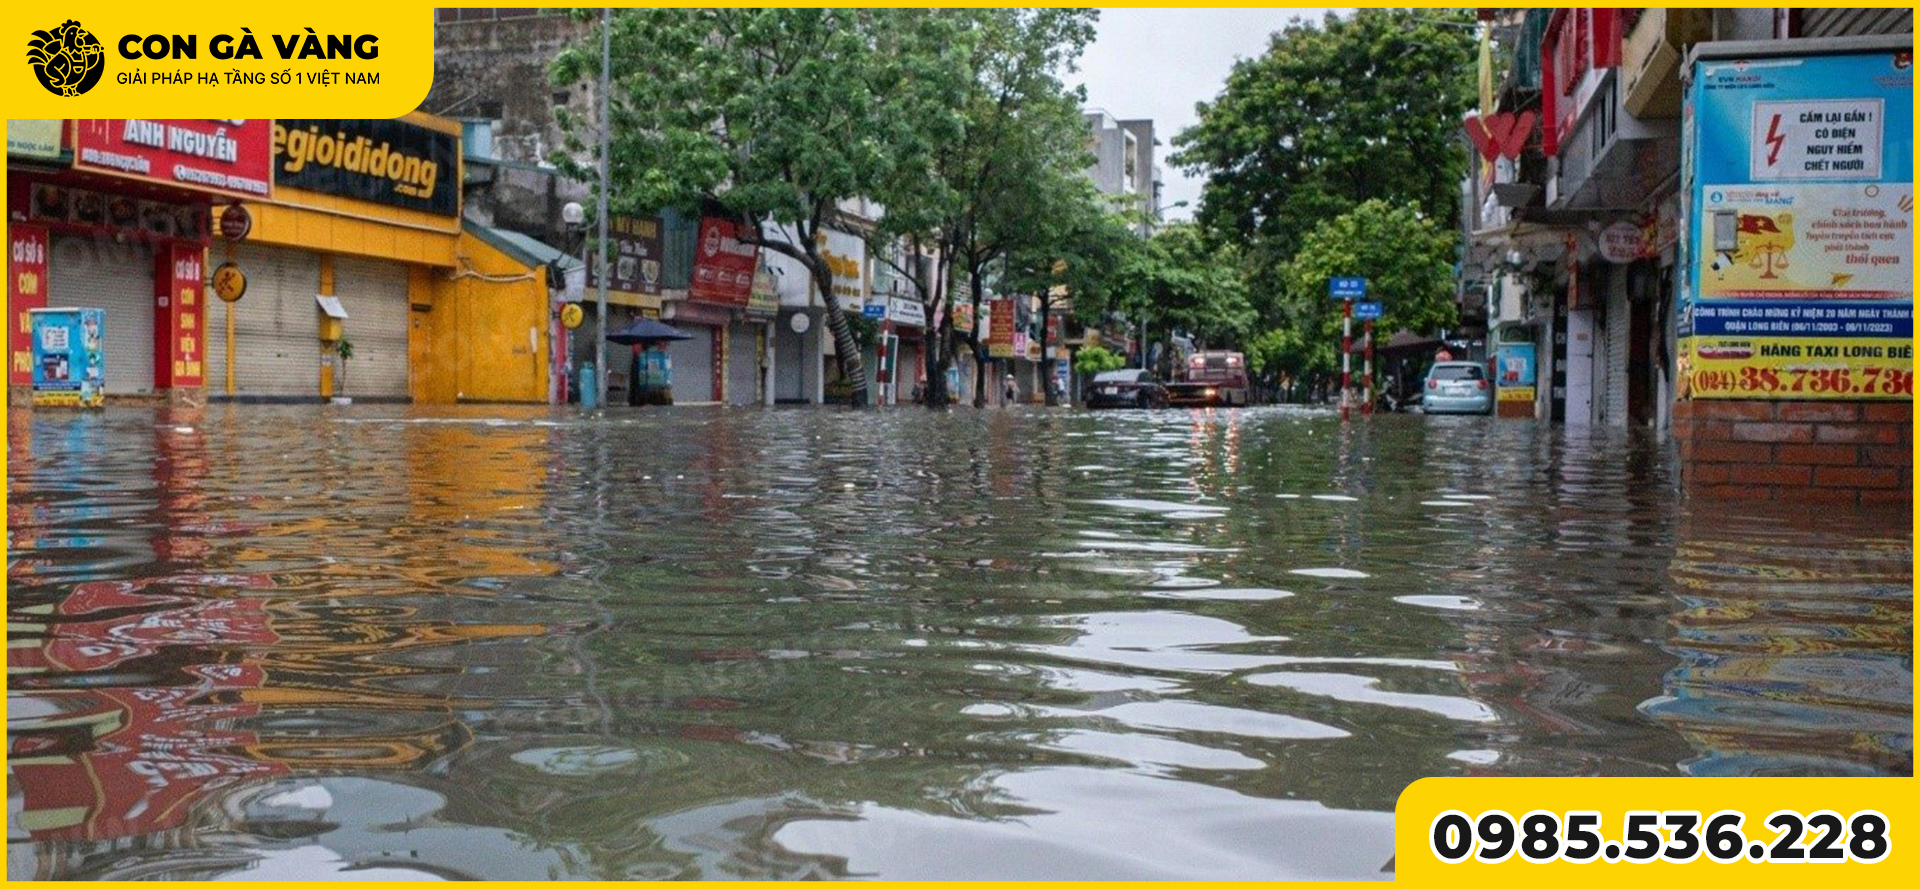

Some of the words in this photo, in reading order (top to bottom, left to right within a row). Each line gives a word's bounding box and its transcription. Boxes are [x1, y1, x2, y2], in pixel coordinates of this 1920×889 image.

[1800, 109, 1823, 124] CẤM
[1825, 113, 1842, 126] LẠI
[1815, 127, 1829, 139] CÓ
[1831, 126, 1856, 141] ĐIỆN
[168, 127, 238, 163] NGUYỄN
[1806, 144, 1834, 155] NGUY
[1836, 141, 1863, 155] HIỂM
[1804, 159, 1831, 171] CHẾT
[1832, 159, 1864, 171] NGƯỜI
[1845, 253, 1870, 264] thói
[1871, 255, 1901, 267] quen
[1694, 306, 1716, 317] CÔNG
[1717, 307, 1741, 317] TRÌNH
[1742, 307, 1763, 318] CHÀO
[1764, 307, 1789, 318] MỪNG
[1802, 307, 1824, 319] NIỆM
[1825, 309, 1836, 318] 20
[1837, 308, 1857, 318] NĂM
[1858, 308, 1881, 318] NGÀY
[1882, 308, 1909, 319] THÀNH
[1724, 320, 1747, 332] QUẬN
[1748, 321, 1769, 331] LONG
[1770, 320, 1790, 331] BIÊN
[1806, 345, 1839, 357] TAXI
[1843, 346, 1883, 358] LONG
[1692, 369, 1736, 393] (024)
